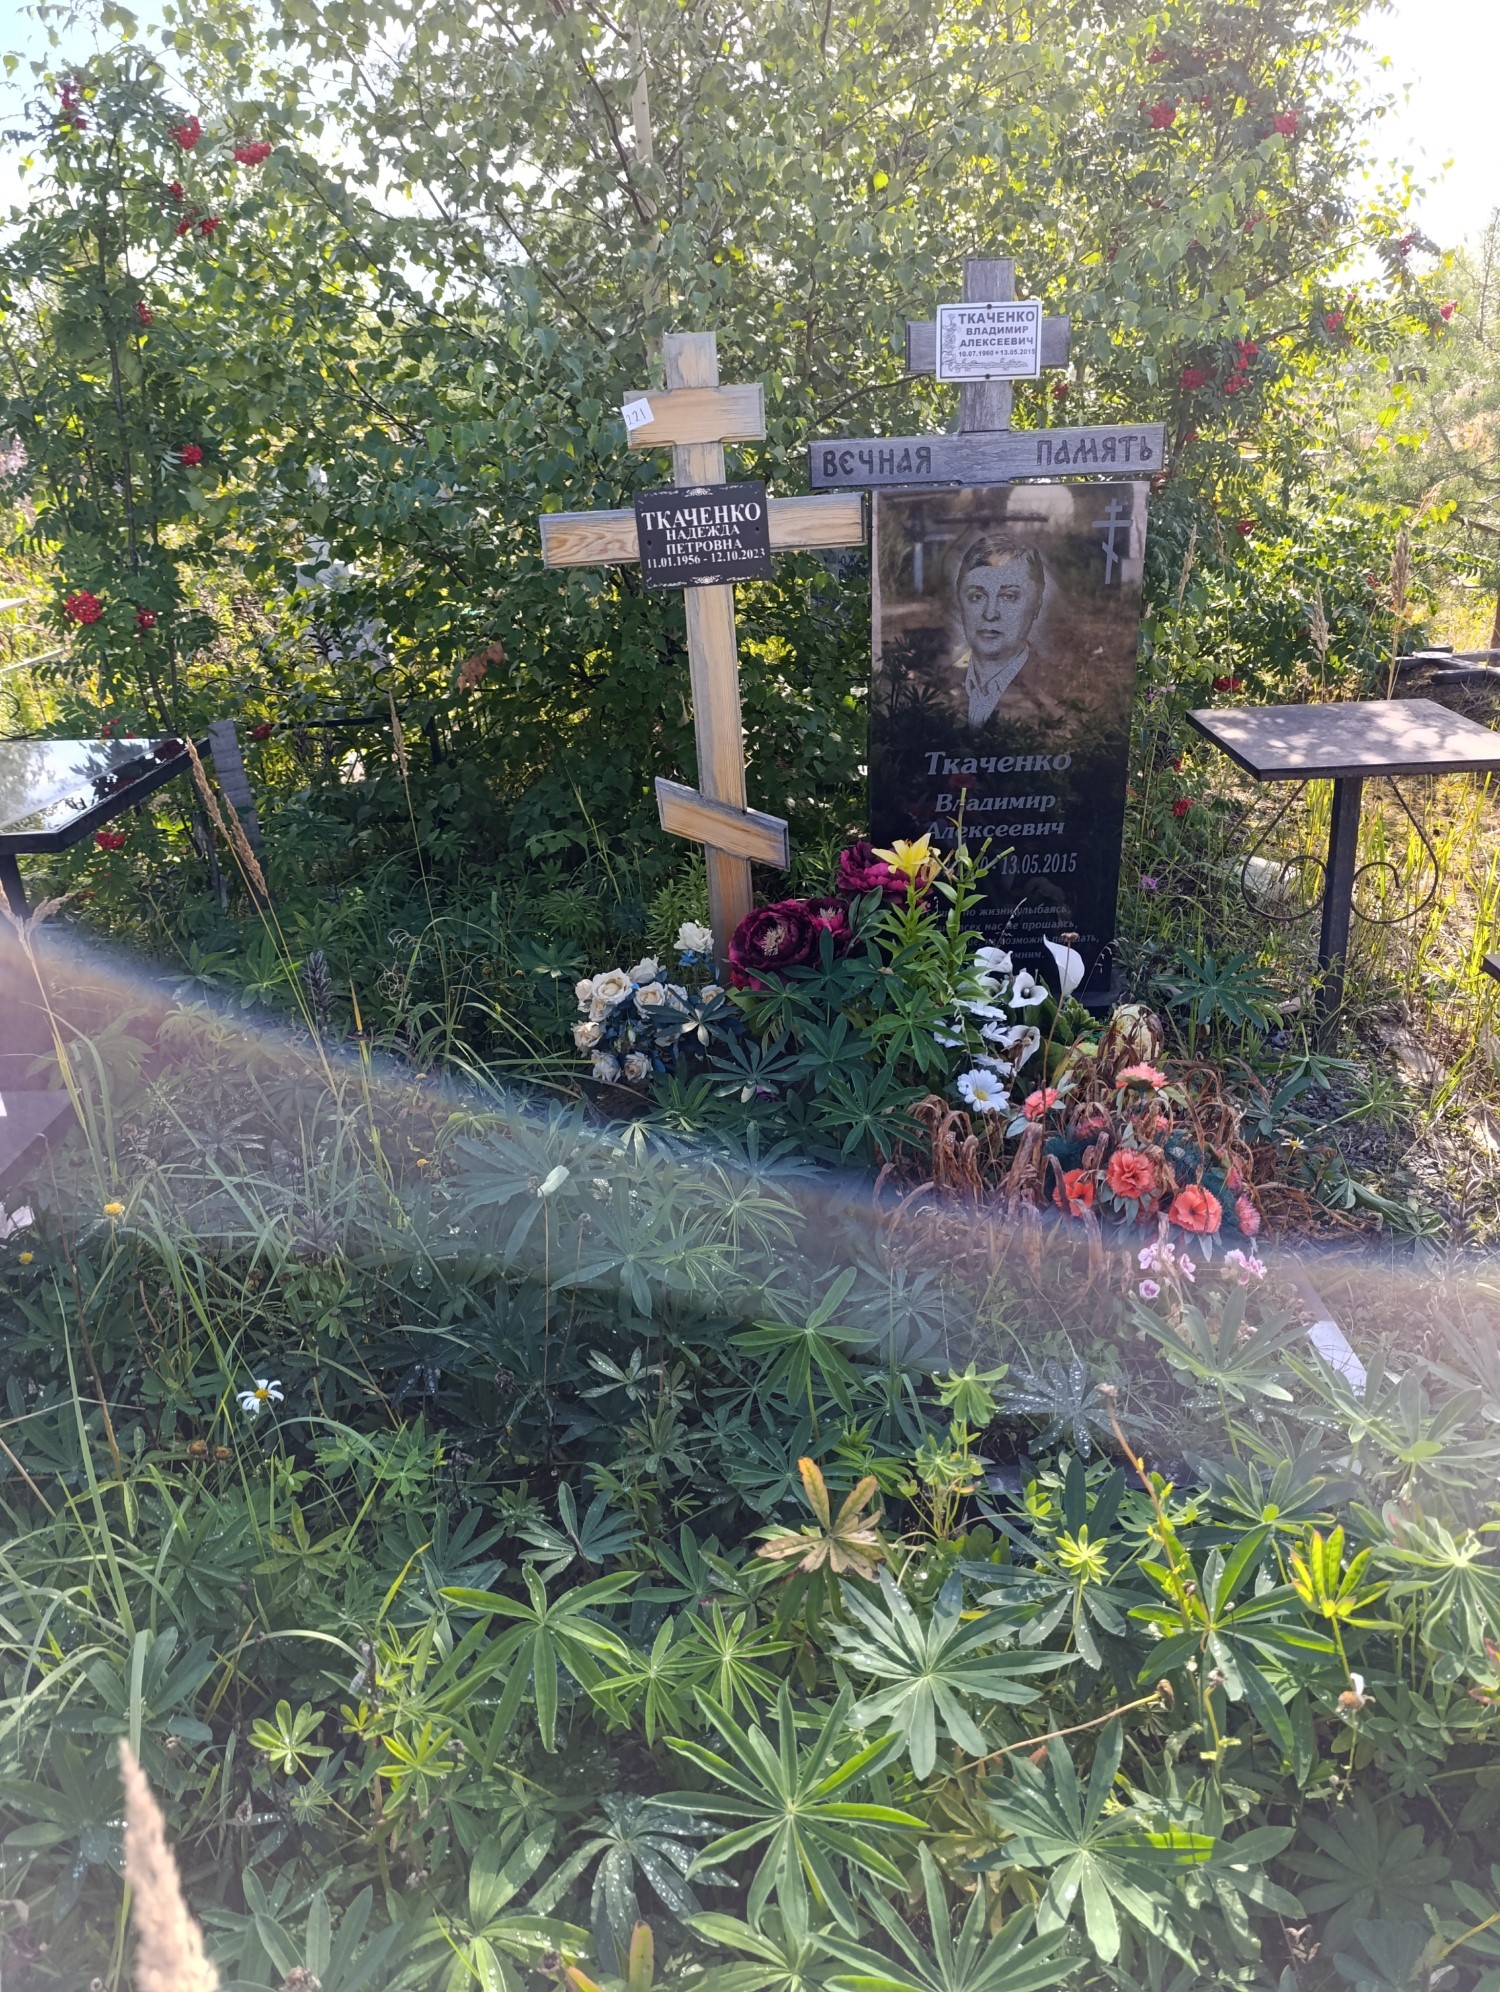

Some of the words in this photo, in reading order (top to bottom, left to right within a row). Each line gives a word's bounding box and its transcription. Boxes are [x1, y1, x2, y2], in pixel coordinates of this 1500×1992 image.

[958, 311, 1035, 324] ТКАЧЕНКО
[966, 326, 1029, 336] ВЛАДИМИР
[960, 337, 1034, 347] АЛЕКСЕЕВИЧ
[626, 408, 647, 426] 221
[823, 446, 931, 478] ВЕЧНАЯ
[1036, 436, 1153, 467] ПАМЯТЬ
[641, 502, 761, 531] ТКАЧЕНКО
[666, 524, 741, 541] НАДЕЖДА
[666, 538, 743, 556] ПЕТРОВНА
[647, 554, 700, 569] 11.01.1956
[711, 548, 766, 563] 12.10.2023
[925, 751, 1072, 776] Ткаченко
[926, 821, 1065, 840] Алексеевич
[1001, 853, 1077, 875] 13.05.2015
[980, 907, 1012, 916] жизни
[985, 923, 1004, 931] нас
